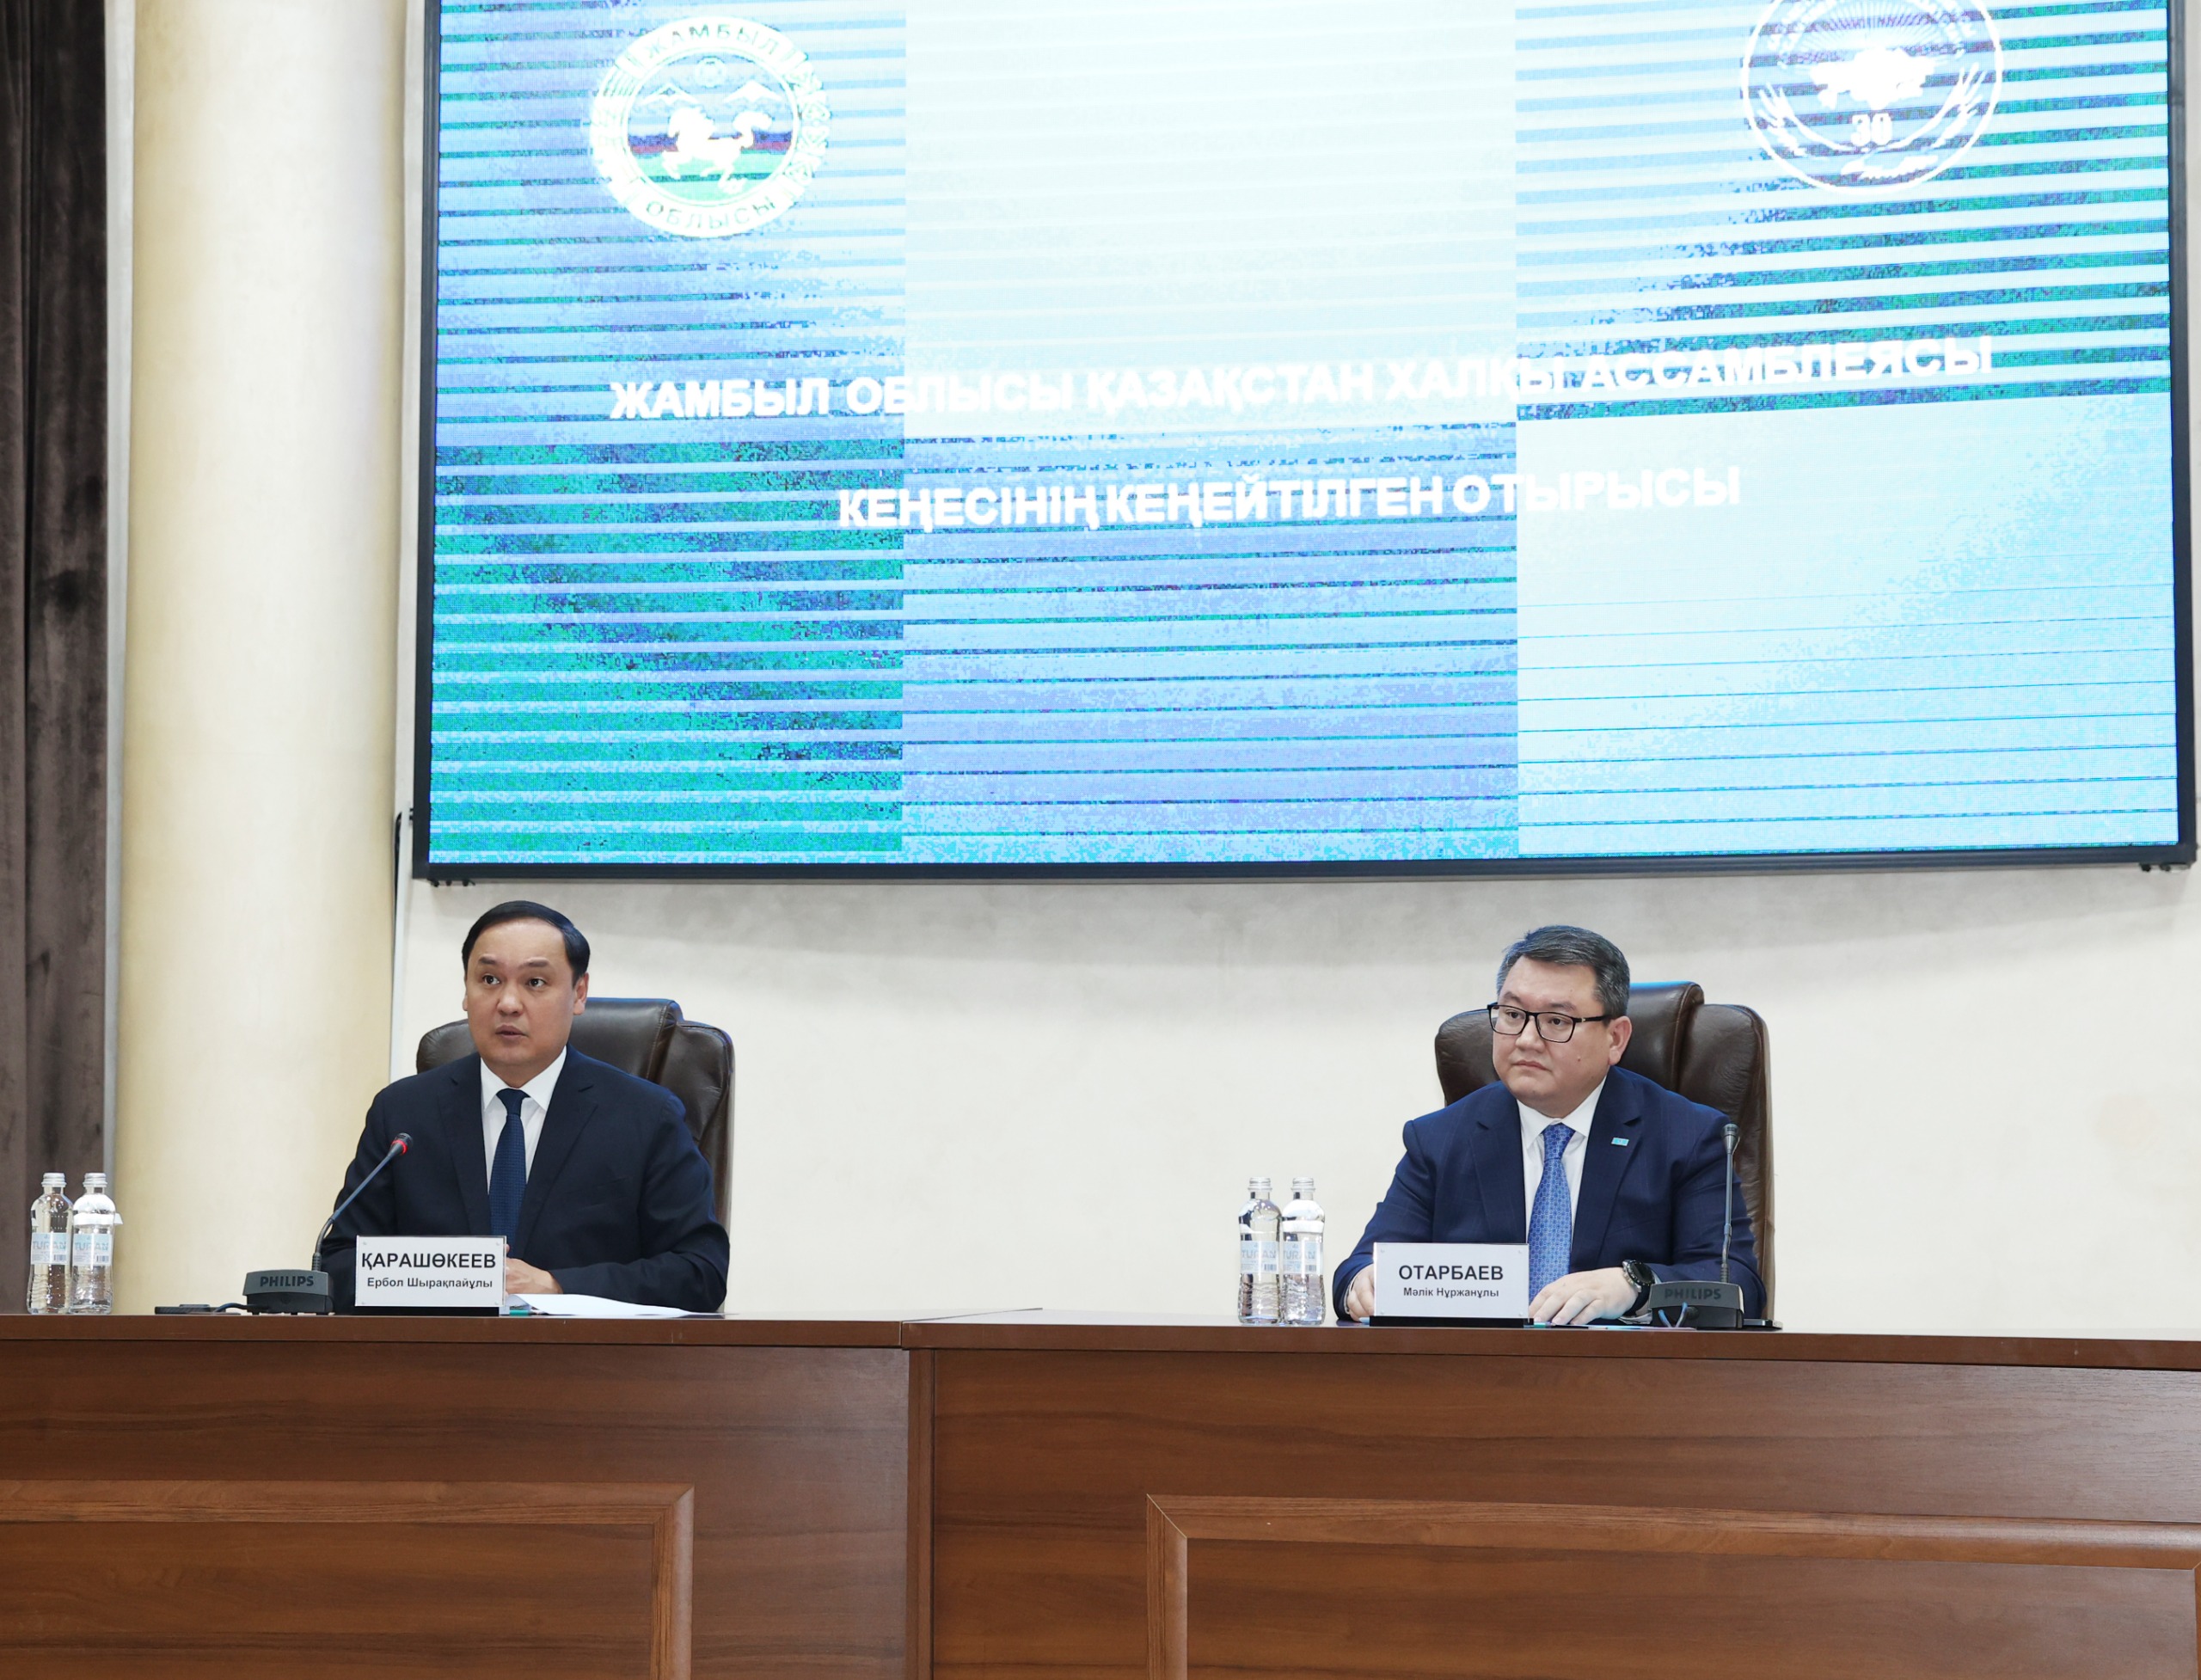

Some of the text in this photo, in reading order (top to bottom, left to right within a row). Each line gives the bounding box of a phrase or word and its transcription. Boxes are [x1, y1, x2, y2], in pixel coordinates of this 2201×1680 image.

[646, 22, 782, 58] ЖАМБЫЛ
[1850, 113, 1893, 147] 30
[645, 195, 777, 230] ОБЛЫСЫ
[610, 335, 1992, 419] ЖАМБЫЛ ОБЛЫСЫ ҚАЗАҚСТАН ХАЛҚЫ АССАМБЛЕЯСЫ
[838, 466, 1740, 531] КЕҢЕСІНІҢ КЕҢЕЙТІЛГЕН ОТЫРЫСЫ
[361, 1252, 496, 1270] ҚАРАШӨКЕЕВ
[1283, 1250, 1315, 1260] TURN
[1398, 1265, 1504, 1280] ОТАРБАЕВ
[260, 1275, 315, 1288] PHILIPS
[366, 1277, 494, 1290] Ербол Шырақпайұлы
[1403, 1287, 1499, 1299] Мәлік Нұржанұлы
[1664, 1288, 1722, 1300] PHILIPS
